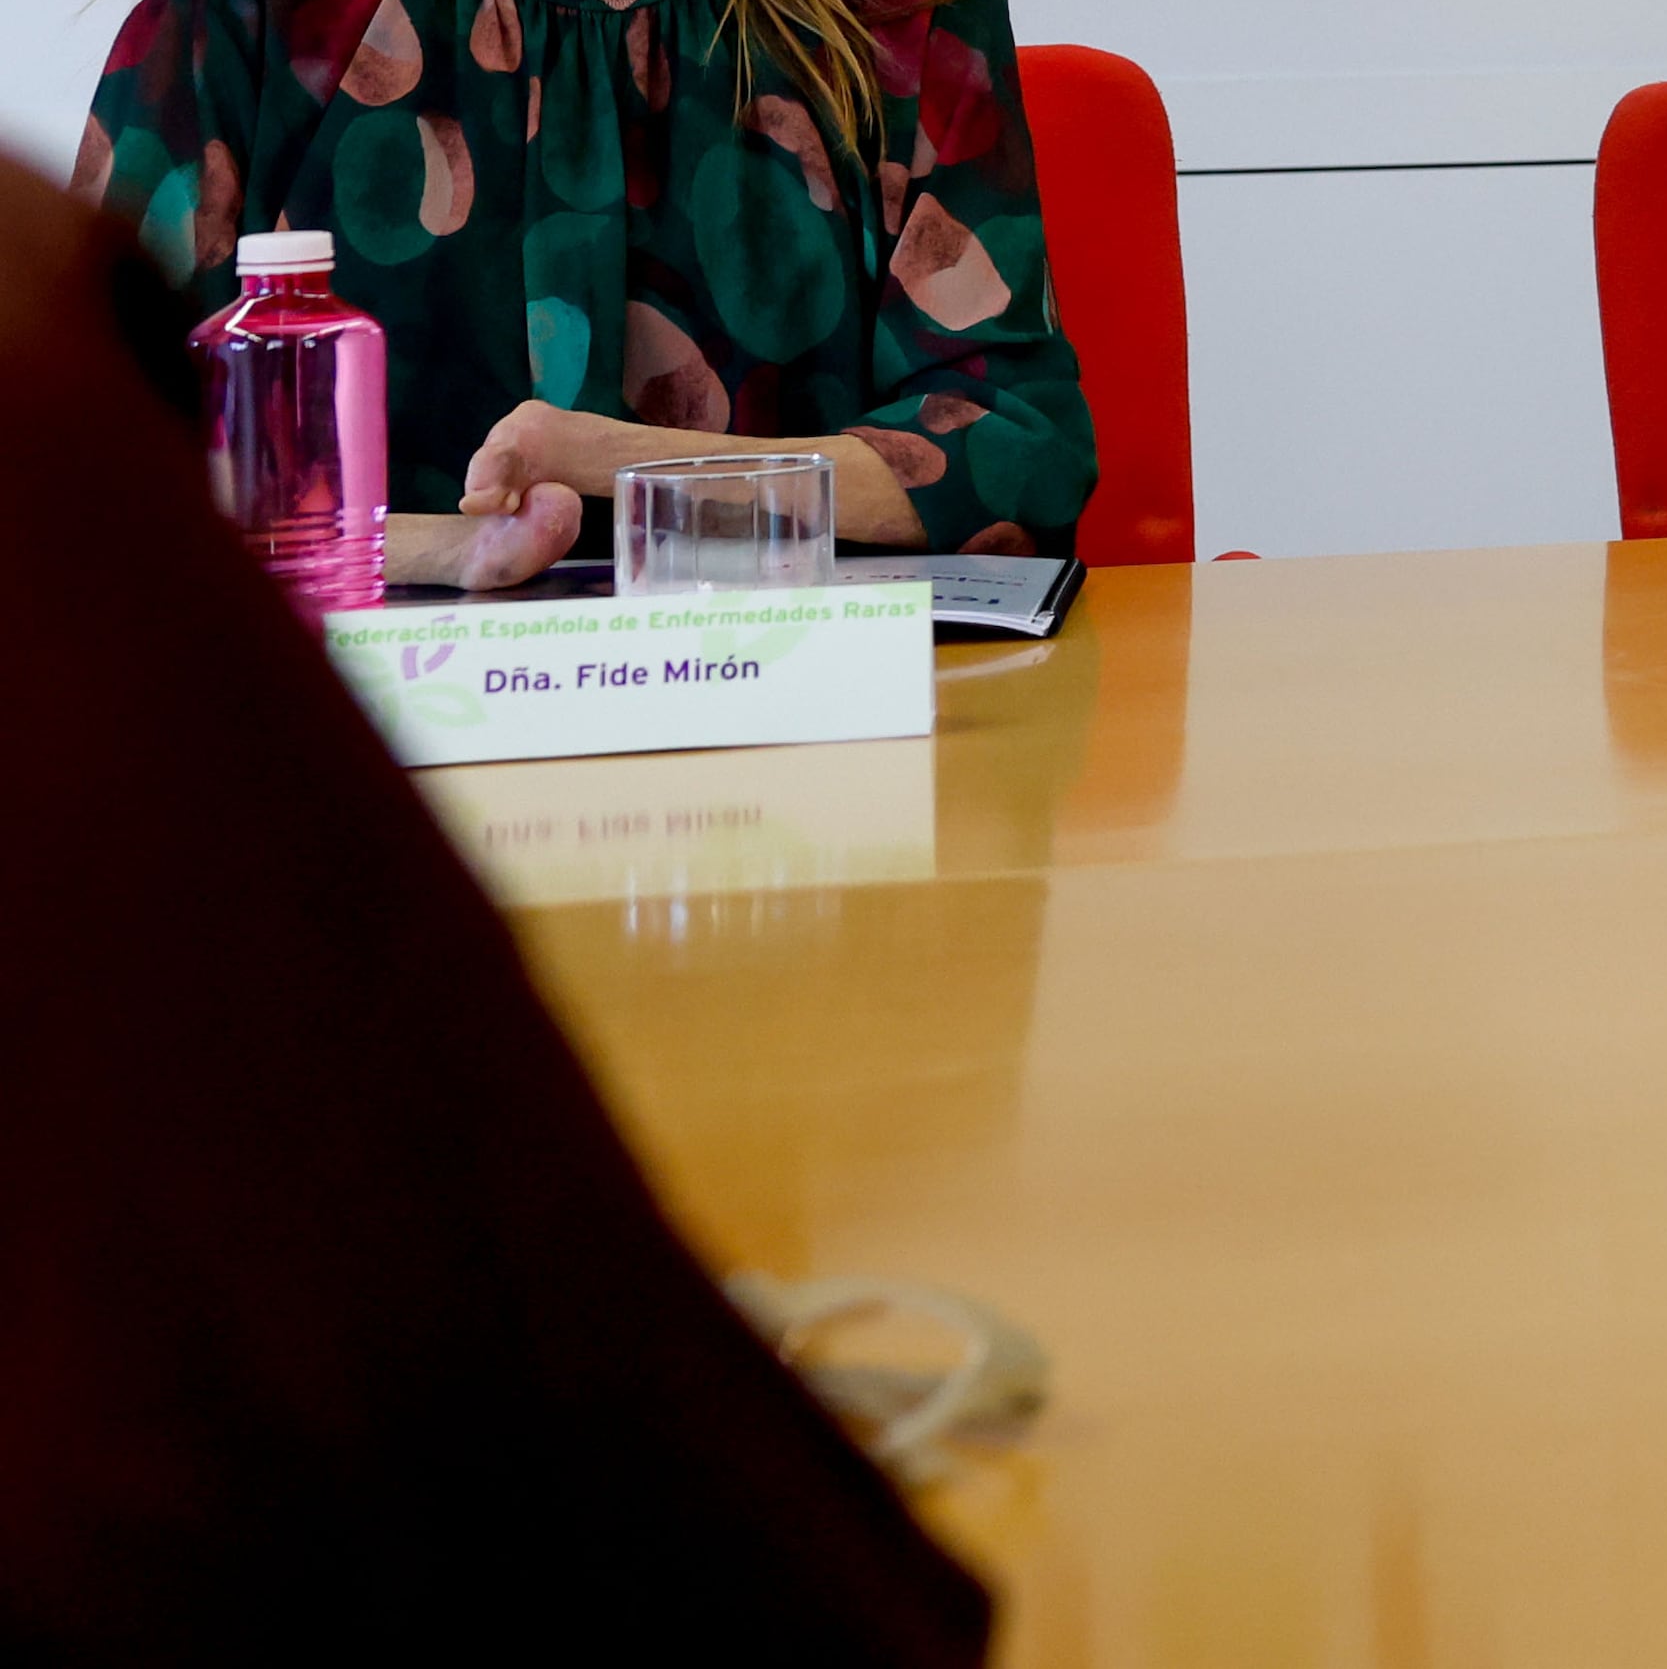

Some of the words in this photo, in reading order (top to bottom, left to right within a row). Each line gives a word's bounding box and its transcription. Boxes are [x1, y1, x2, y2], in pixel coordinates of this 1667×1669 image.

[479, 614, 600, 640] Española
[608, 612, 639, 632] de
[649, 602, 834, 629] Enfermedades
[844, 590, 917, 619] Raras
[485, 667, 562, 694] Dña.
[576, 661, 649, 689] Fide
[663, 654, 760, 683] Mirón
